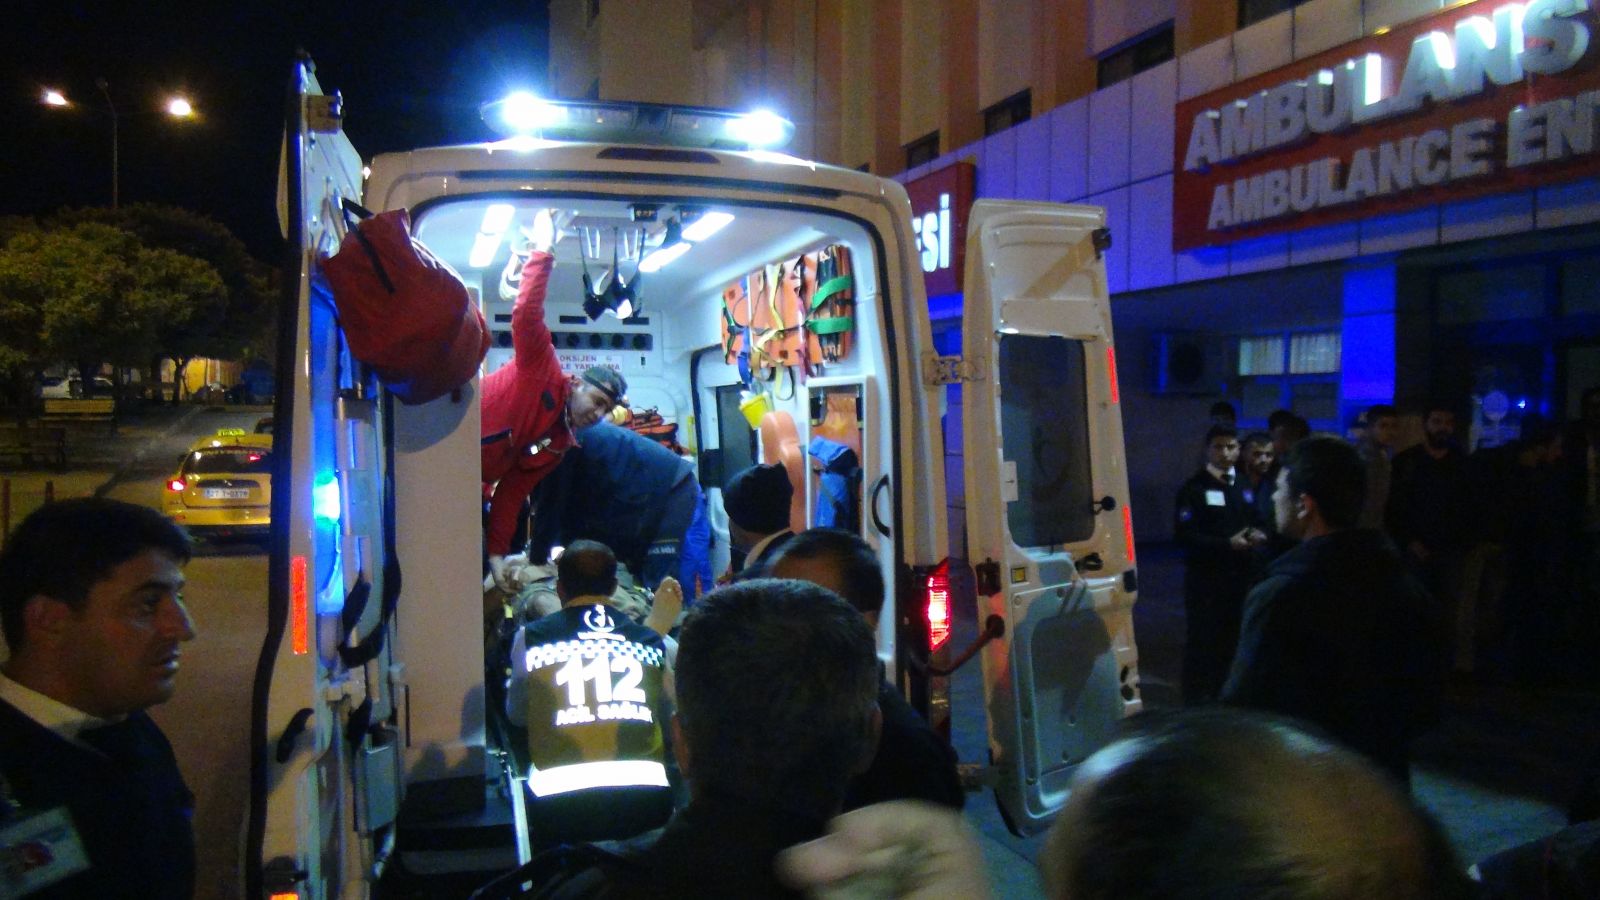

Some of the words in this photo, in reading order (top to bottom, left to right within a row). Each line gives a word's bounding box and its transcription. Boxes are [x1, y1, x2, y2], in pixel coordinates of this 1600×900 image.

[1183, 0, 1589, 172] AMBULANS
[1207, 118, 1496, 231] AMBULANCE
[1506, 90, 1600, 169] EN
[556, 649, 646, 705] 112
